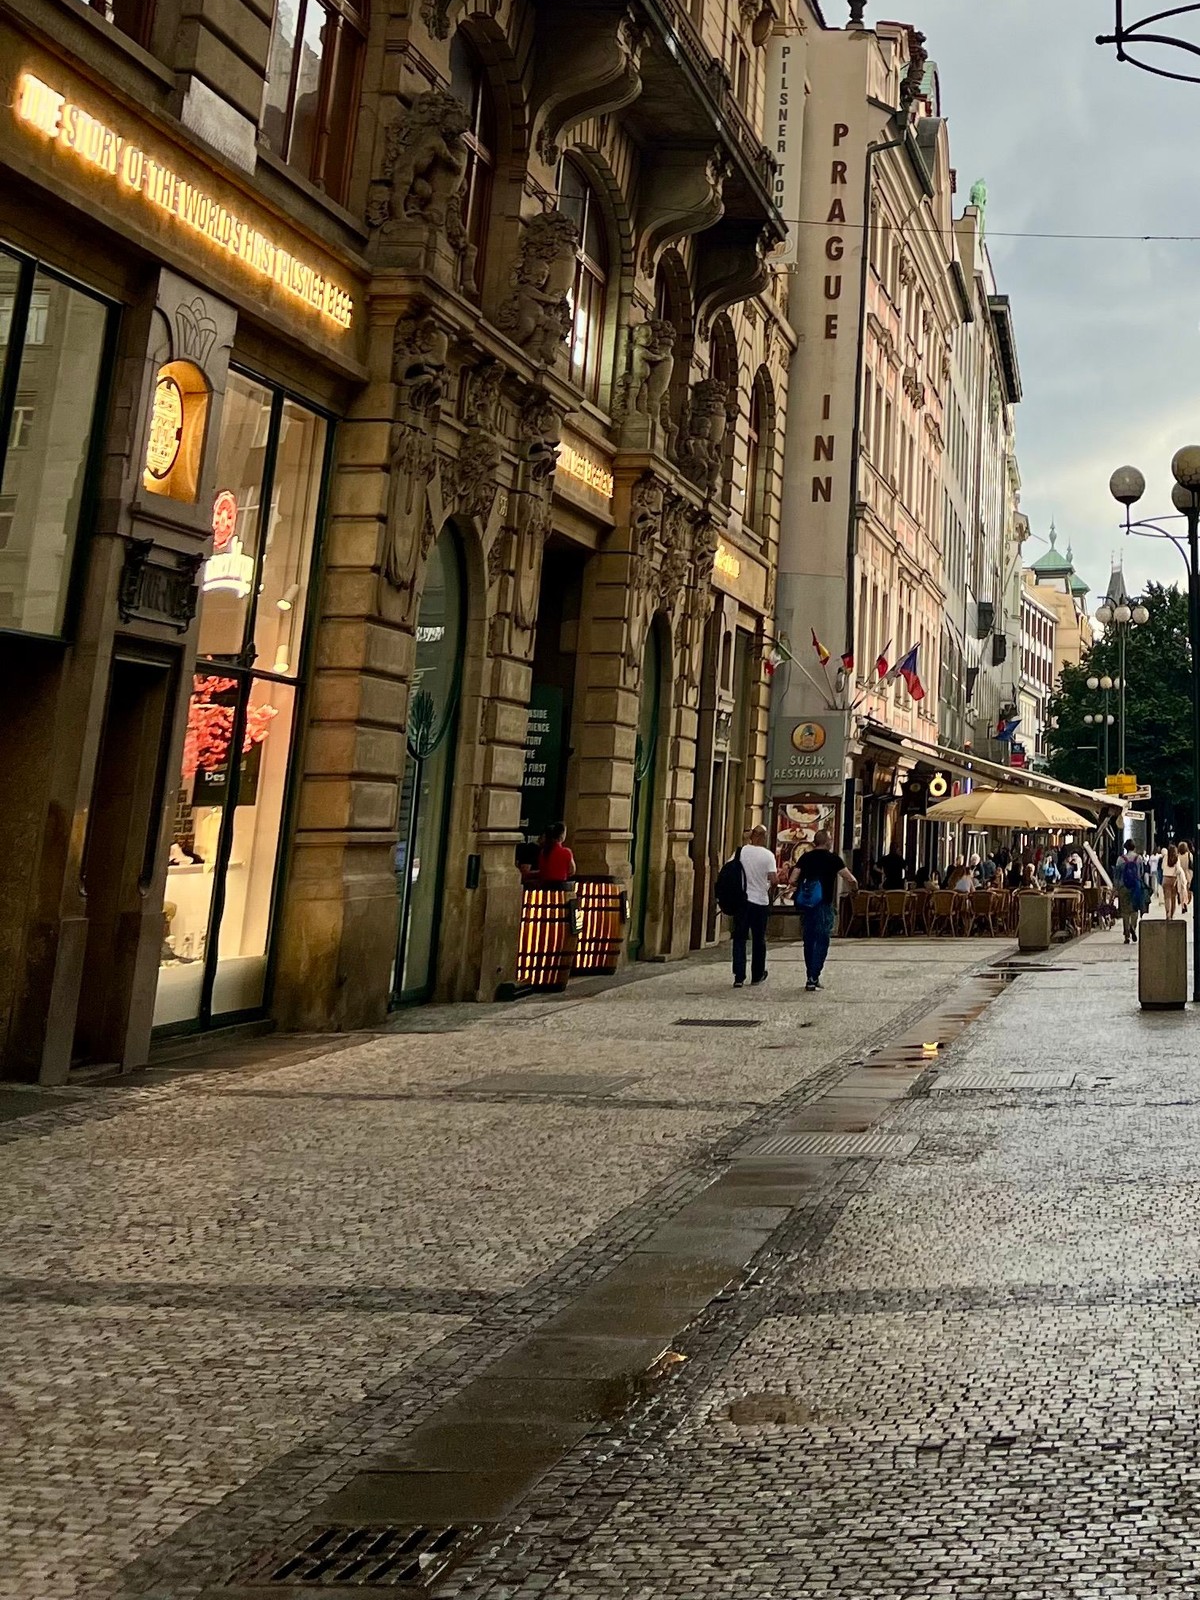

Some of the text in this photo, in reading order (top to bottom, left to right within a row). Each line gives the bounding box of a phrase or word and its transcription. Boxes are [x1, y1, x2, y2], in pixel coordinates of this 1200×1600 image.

[774, 46, 791, 209] PILSNER TOU
[61, 104, 124, 176] STORY
[147, 159, 179, 215] THE
[238, 223, 276, 278] FIRST
[273, 248, 324, 311] PILSNER
[322, 281, 353, 329] BEER
[811, 122, 849, 503] PRAGUE INN
[524, 777, 545, 787] LAGER
[773, 767, 841, 779] RESTAURANT
